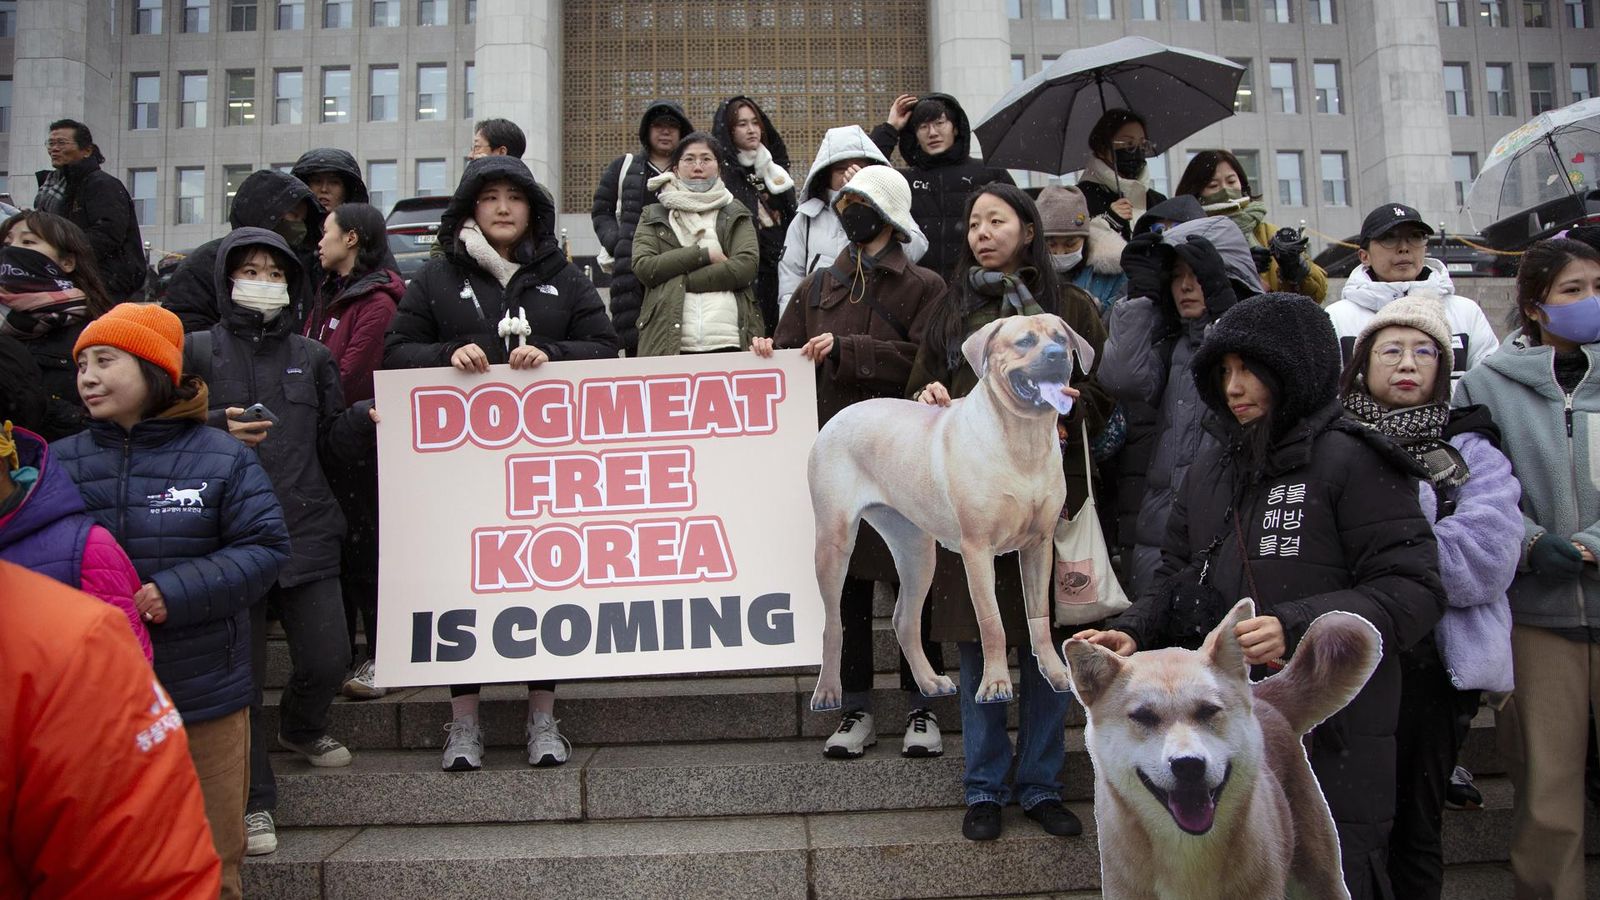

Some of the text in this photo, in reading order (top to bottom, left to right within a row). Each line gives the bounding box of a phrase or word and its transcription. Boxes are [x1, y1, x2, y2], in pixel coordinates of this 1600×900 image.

[412, 368, 786, 453] DOG MEAT
[506, 446, 697, 519] FREE
[1267, 483, 1307, 505] 동물
[1259, 534, 1301, 557] 물결
[1262, 508, 1305, 530] 해방
[471, 517, 737, 594] KOREA
[411, 593, 795, 663] IS COMING
